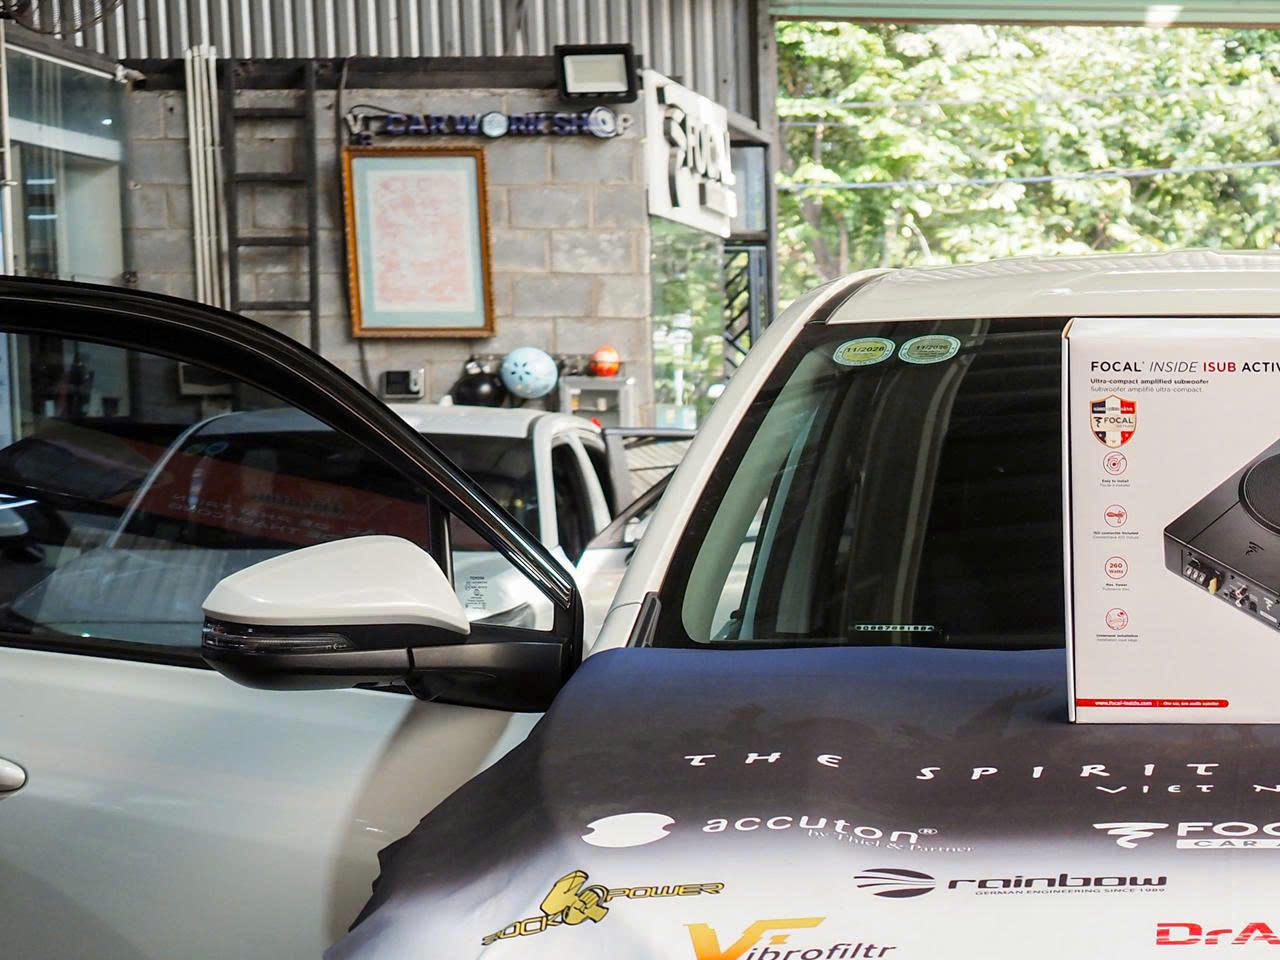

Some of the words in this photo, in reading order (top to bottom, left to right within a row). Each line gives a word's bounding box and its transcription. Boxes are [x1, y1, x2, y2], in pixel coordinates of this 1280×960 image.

[1091, 361, 1143, 373] FOCAL
[1149, 361, 1199, 373] INSIDE
[1203, 361, 1237, 373] ISUB
[1140, 378, 1172, 386] amplified
[684, 751, 843, 768] THE
[916, 763, 1219, 781] SPIRIT
[1096, 783, 1215, 794] VIET
[1193, 839, 1258, 848] CAR
[948, 873, 1168, 890] rainbow
[604, 881, 725, 903] POWER
[1026, 887, 1101, 895] ENGINEERING
